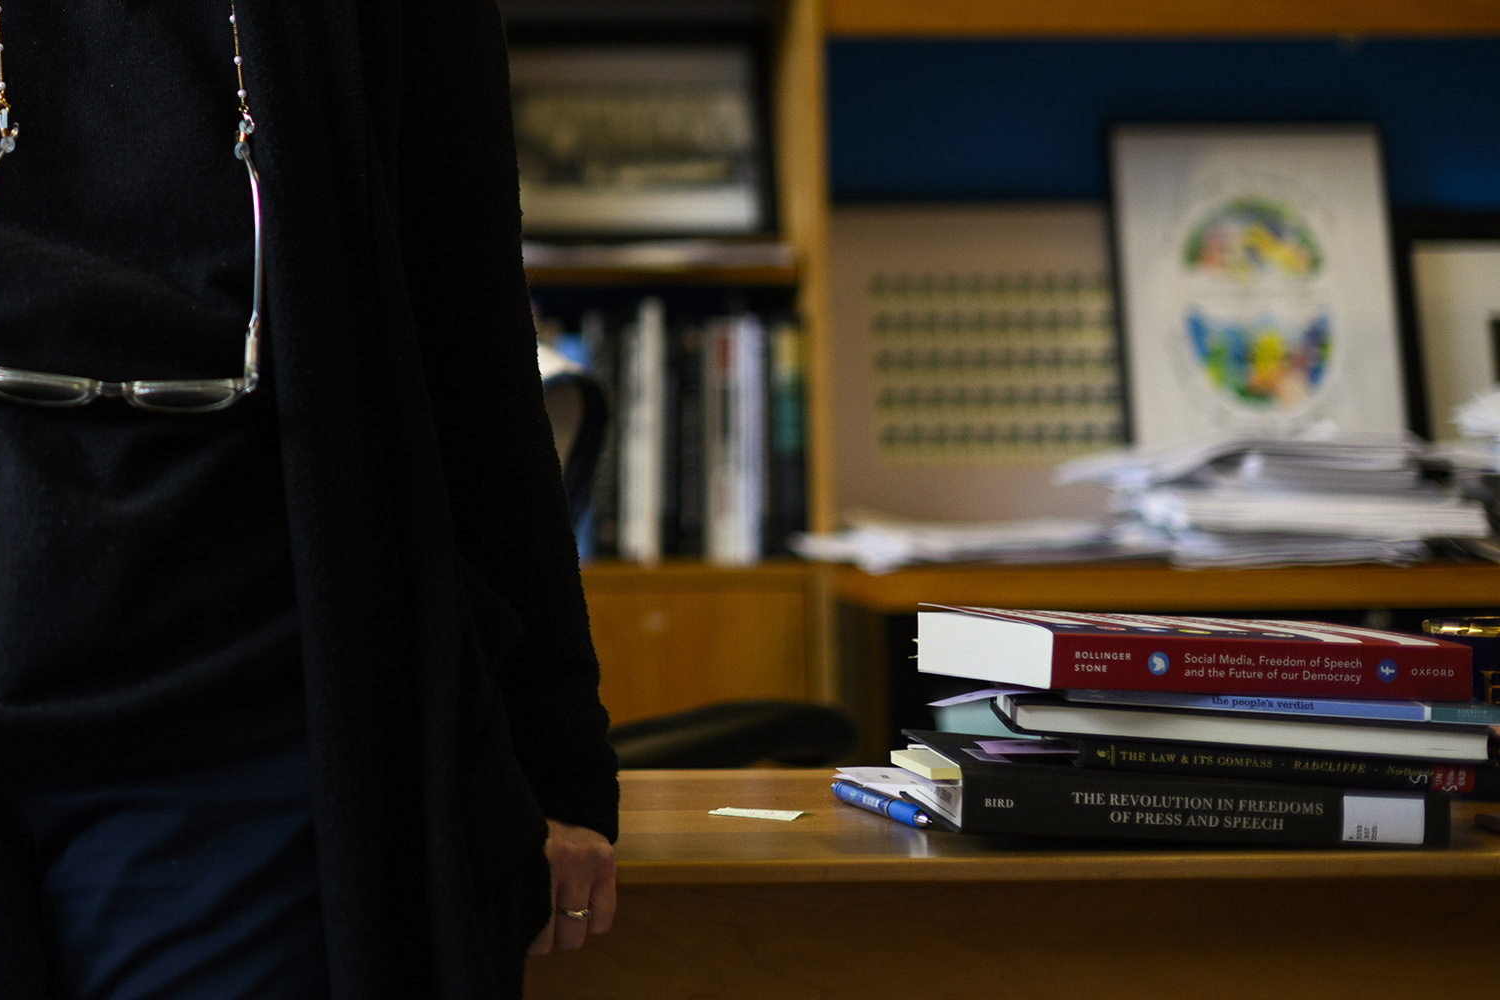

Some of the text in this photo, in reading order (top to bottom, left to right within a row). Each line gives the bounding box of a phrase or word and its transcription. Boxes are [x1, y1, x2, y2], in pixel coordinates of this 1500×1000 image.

[1075, 651, 1132, 660] BOLLINGER
[1184, 653, 1362, 670] Social Media, Freedom of Speech
[1074, 664, 1108, 672] STONE
[1184, 666, 1362, 684] and the Future of our Democracy
[1411, 668, 1455, 677] OXFORD
[1212, 696, 1314, 710] the people's verdict
[1120, 750, 1146, 762] THE
[1151, 752, 1176, 763] LAW
[1180, 754, 1188, 764] &
[1193, 754, 1214, 765] ITS
[1218, 756, 1273, 768] COMPASS
[1294, 760, 1367, 774] RADCLIFFE
[984, 798, 1014, 808] BIRD
[1072, 791, 1324, 815] THE REVOLUTION IN FREEDOMS
[1110, 811, 1284, 830] OF PRESS AND SPEECH
